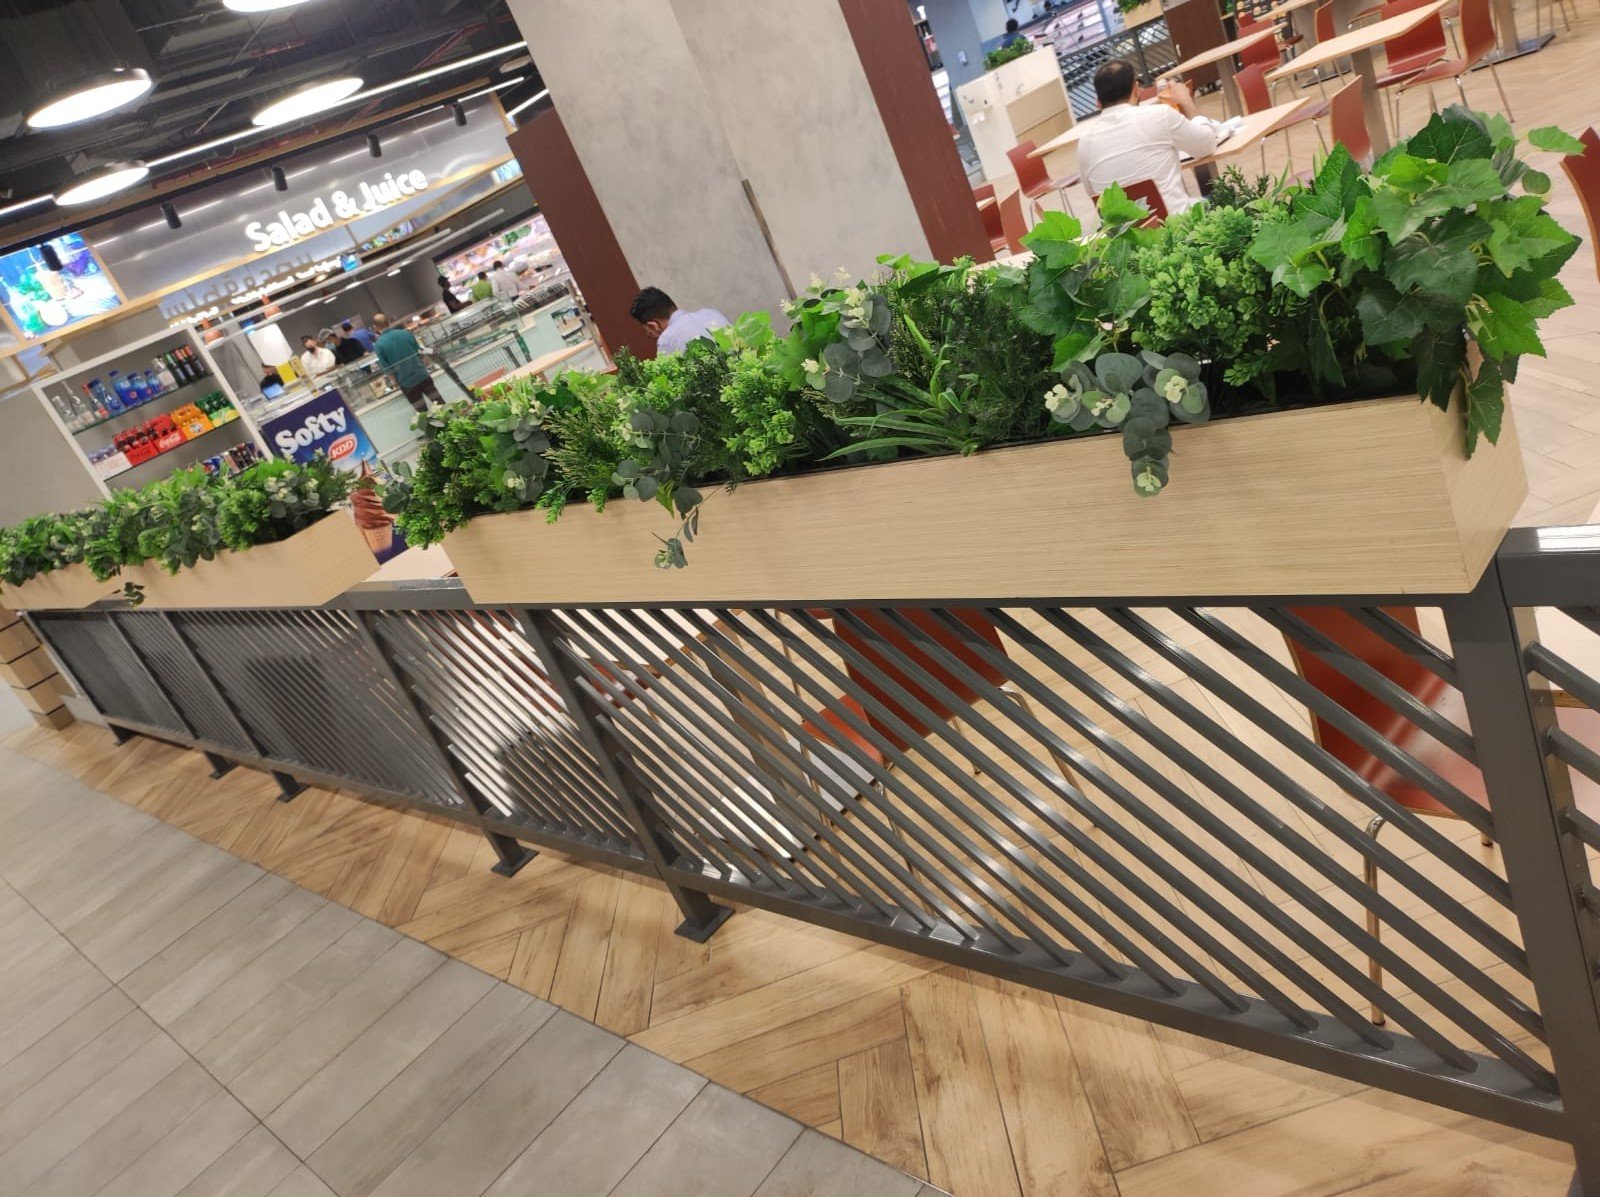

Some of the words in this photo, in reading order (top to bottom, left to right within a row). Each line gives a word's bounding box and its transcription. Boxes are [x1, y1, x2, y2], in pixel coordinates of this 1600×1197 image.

[245, 197, 334, 253] Salad
[331, 190, 361, 219] &
[359, 169, 429, 212] Juice
[275, 406, 347, 455] Softy
[331, 441, 354, 458] KDD
